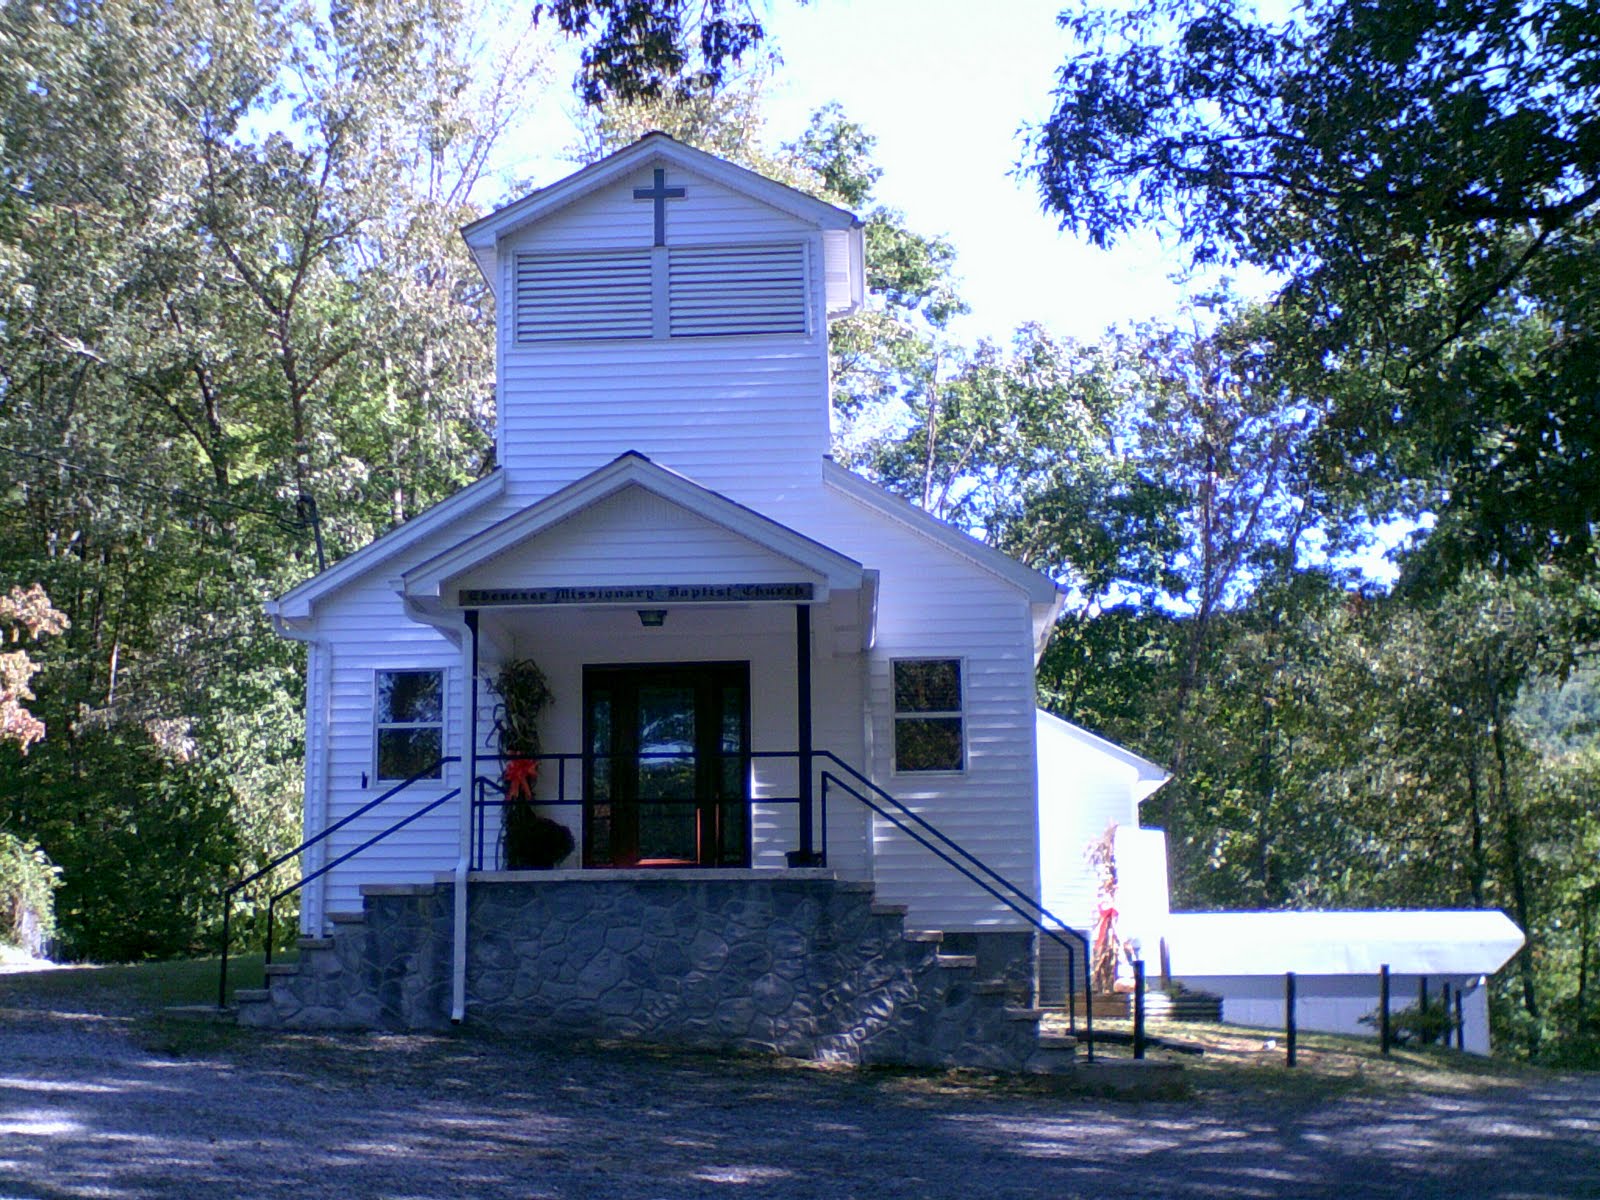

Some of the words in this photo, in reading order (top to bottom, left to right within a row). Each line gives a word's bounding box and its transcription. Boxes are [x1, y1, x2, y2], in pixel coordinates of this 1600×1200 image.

[469, 589, 548, 600] Ebenezer
[554, 586, 654, 600] Missionary
[667, 585, 730, 599] Baptist
[741, 584, 804, 597] Church
